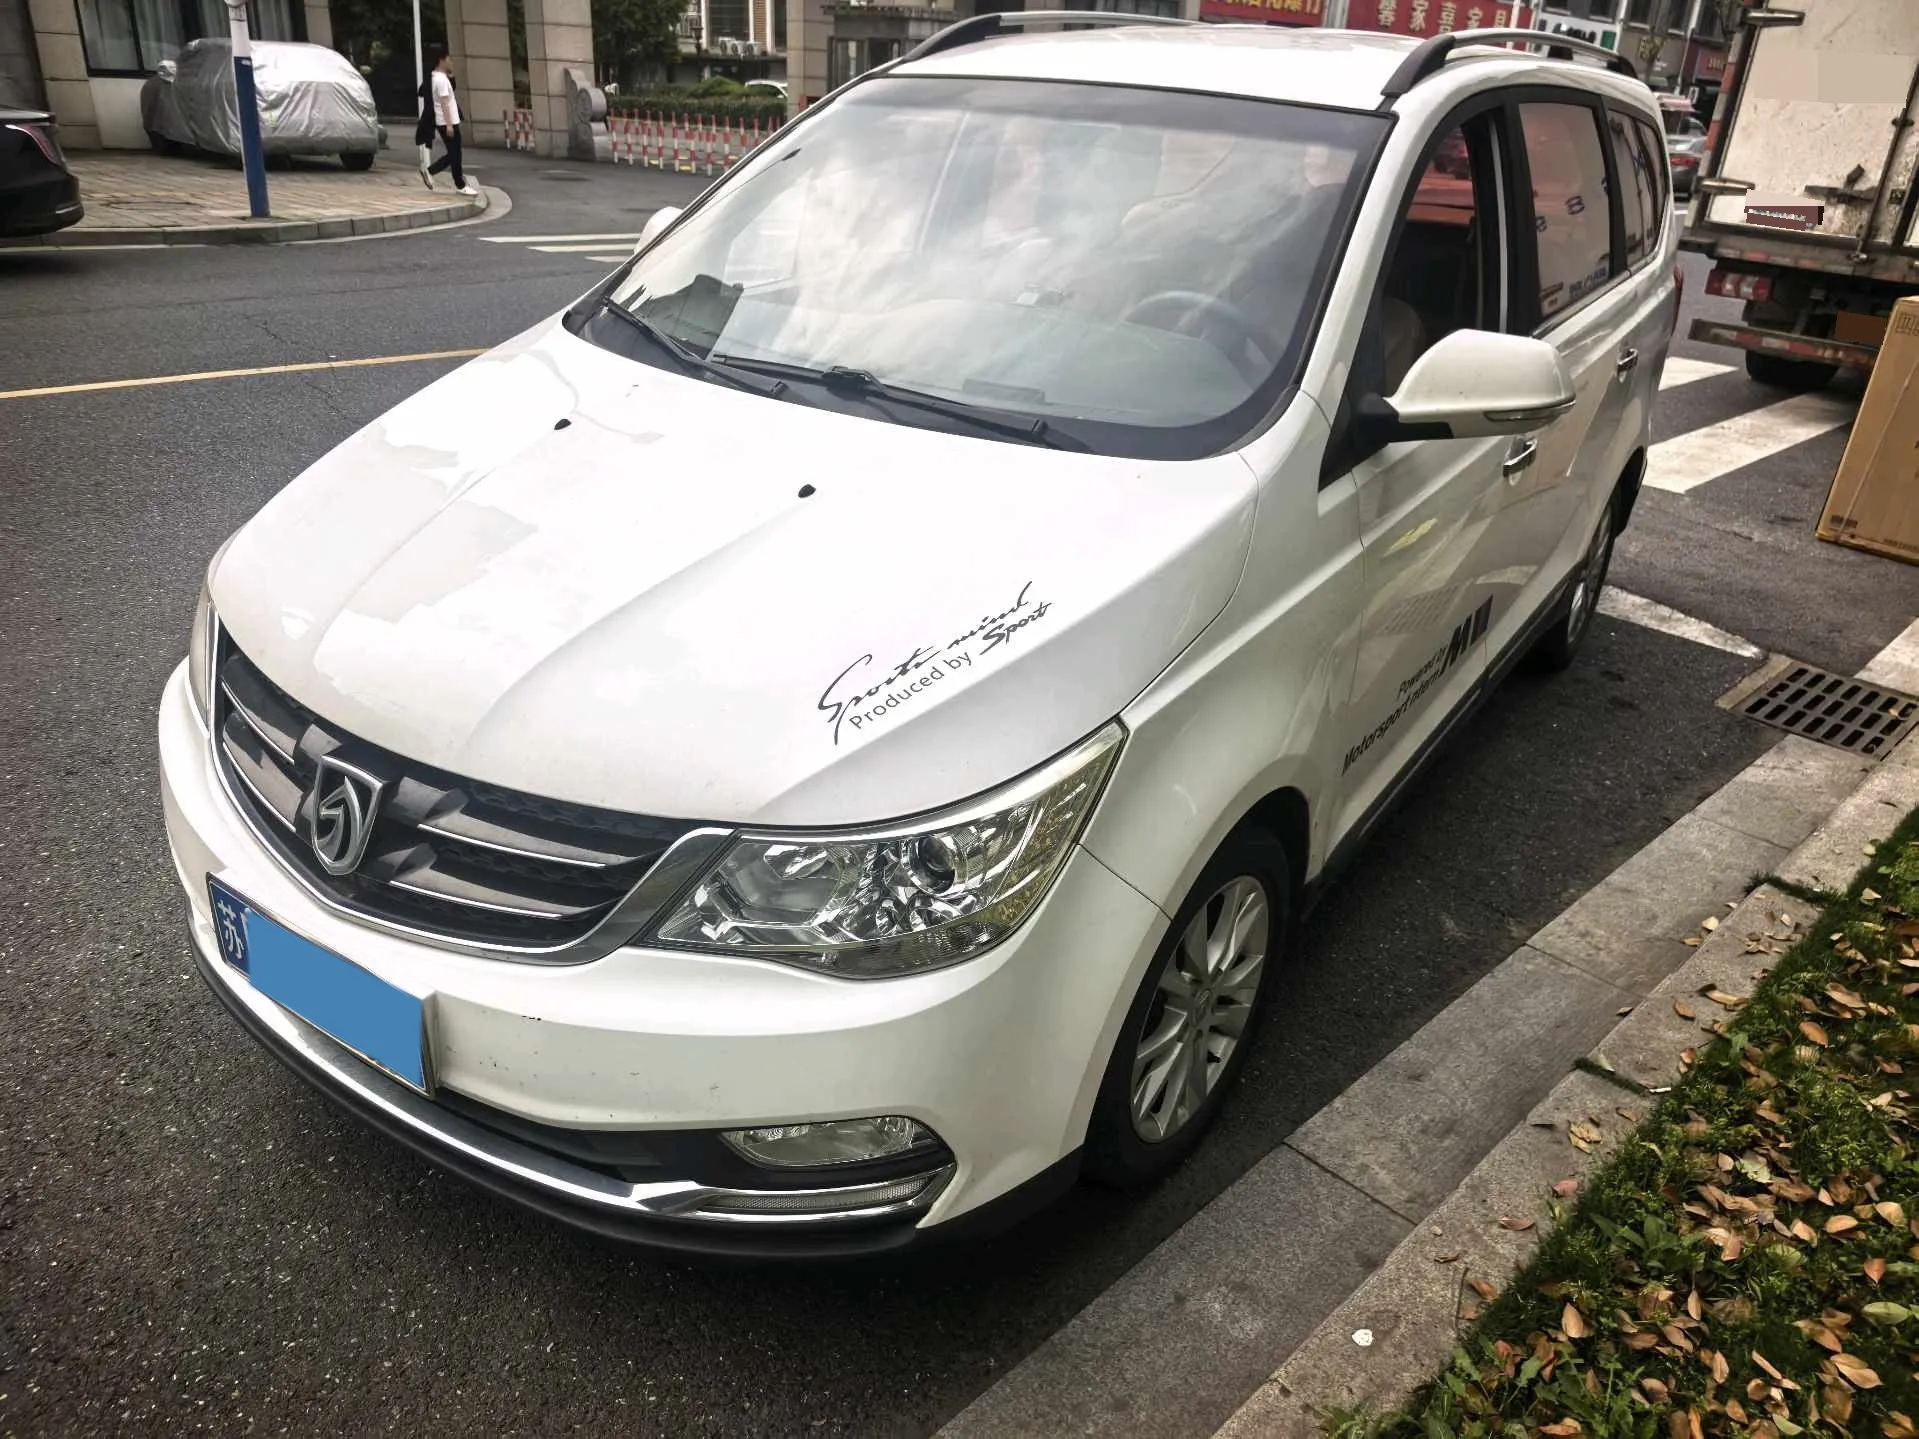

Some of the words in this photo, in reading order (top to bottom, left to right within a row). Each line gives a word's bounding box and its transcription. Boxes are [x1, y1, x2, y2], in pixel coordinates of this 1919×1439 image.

[849, 666, 945, 730] Produced
[943, 651, 972, 673] by
[979, 601, 1053, 656] Sport
[1341, 694, 1411, 777] Motorsport
[217, 898, 248, 960] 苏
